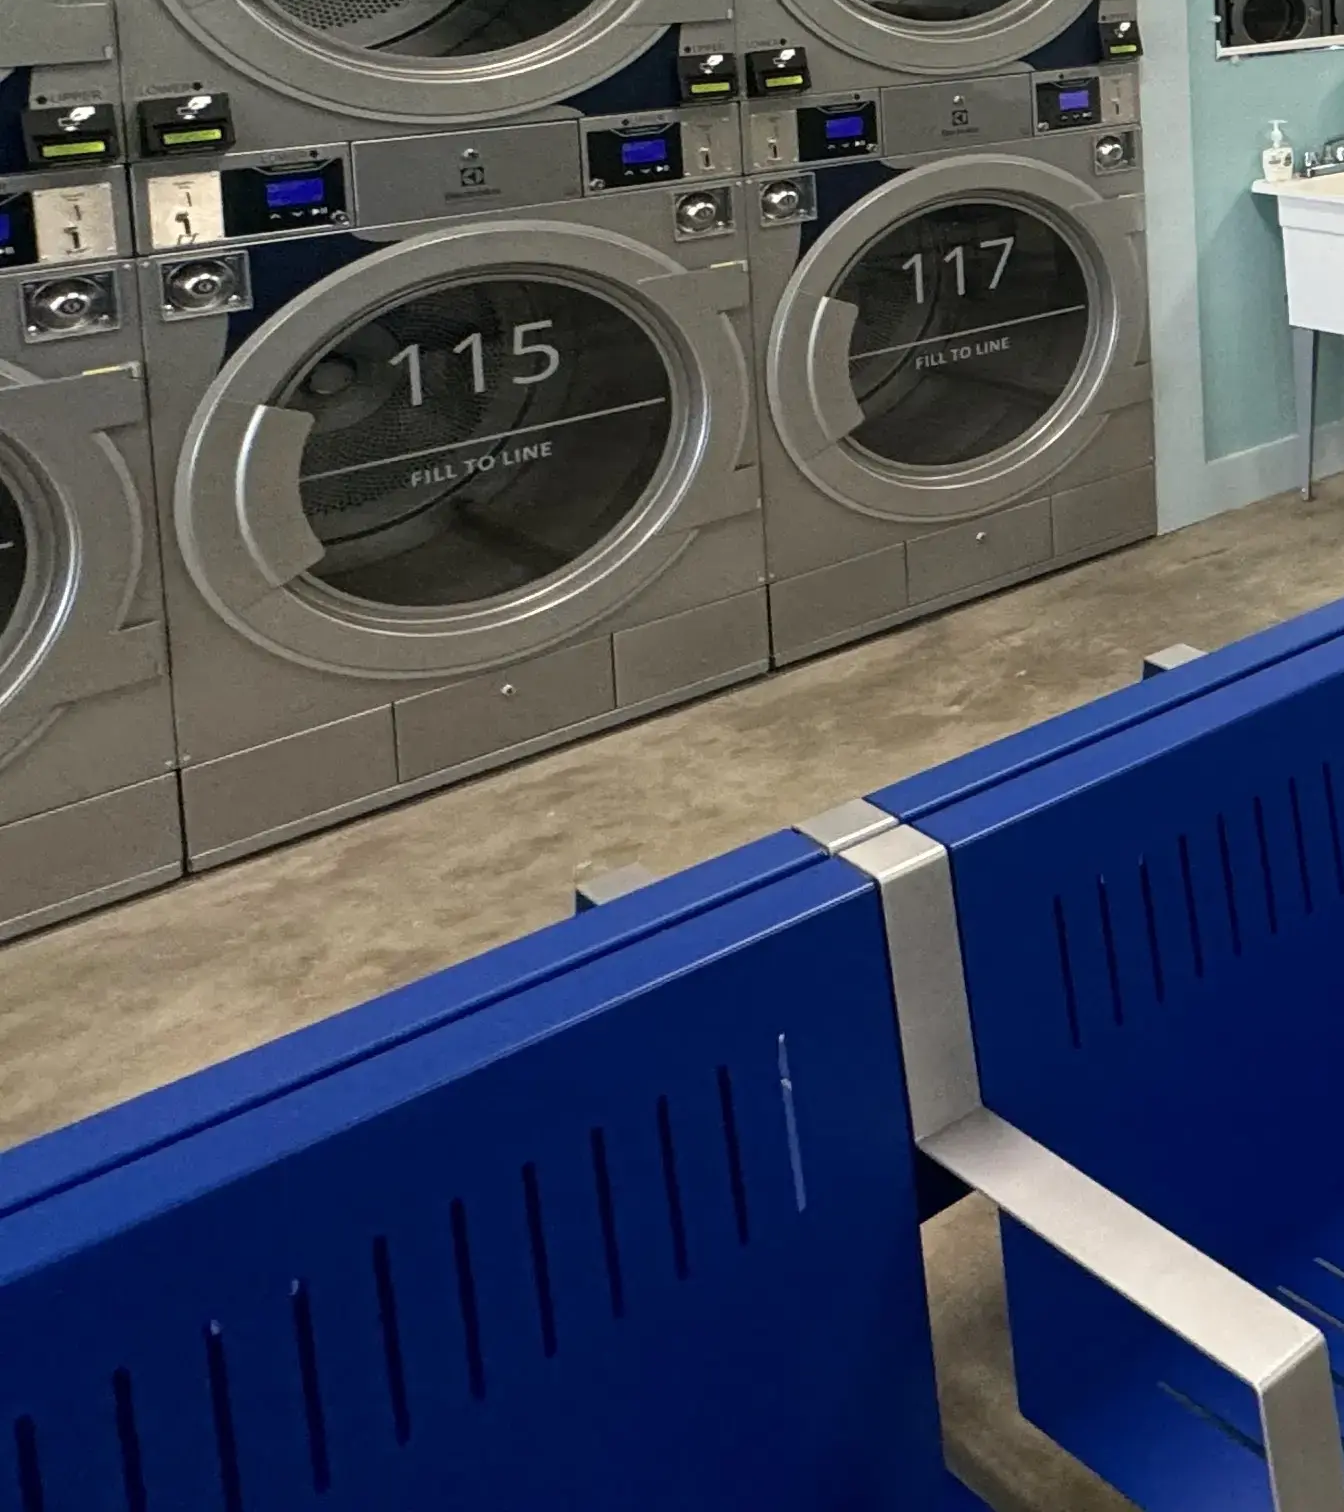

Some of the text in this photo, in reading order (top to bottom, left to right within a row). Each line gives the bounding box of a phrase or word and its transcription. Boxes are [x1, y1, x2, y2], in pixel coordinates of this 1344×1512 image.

[901, 236, 1016, 305] 117
[388, 319, 560, 407] 115
[915, 336, 1011, 370] FILL TO LINE
[410, 441, 553, 488] FILL TO LINE
